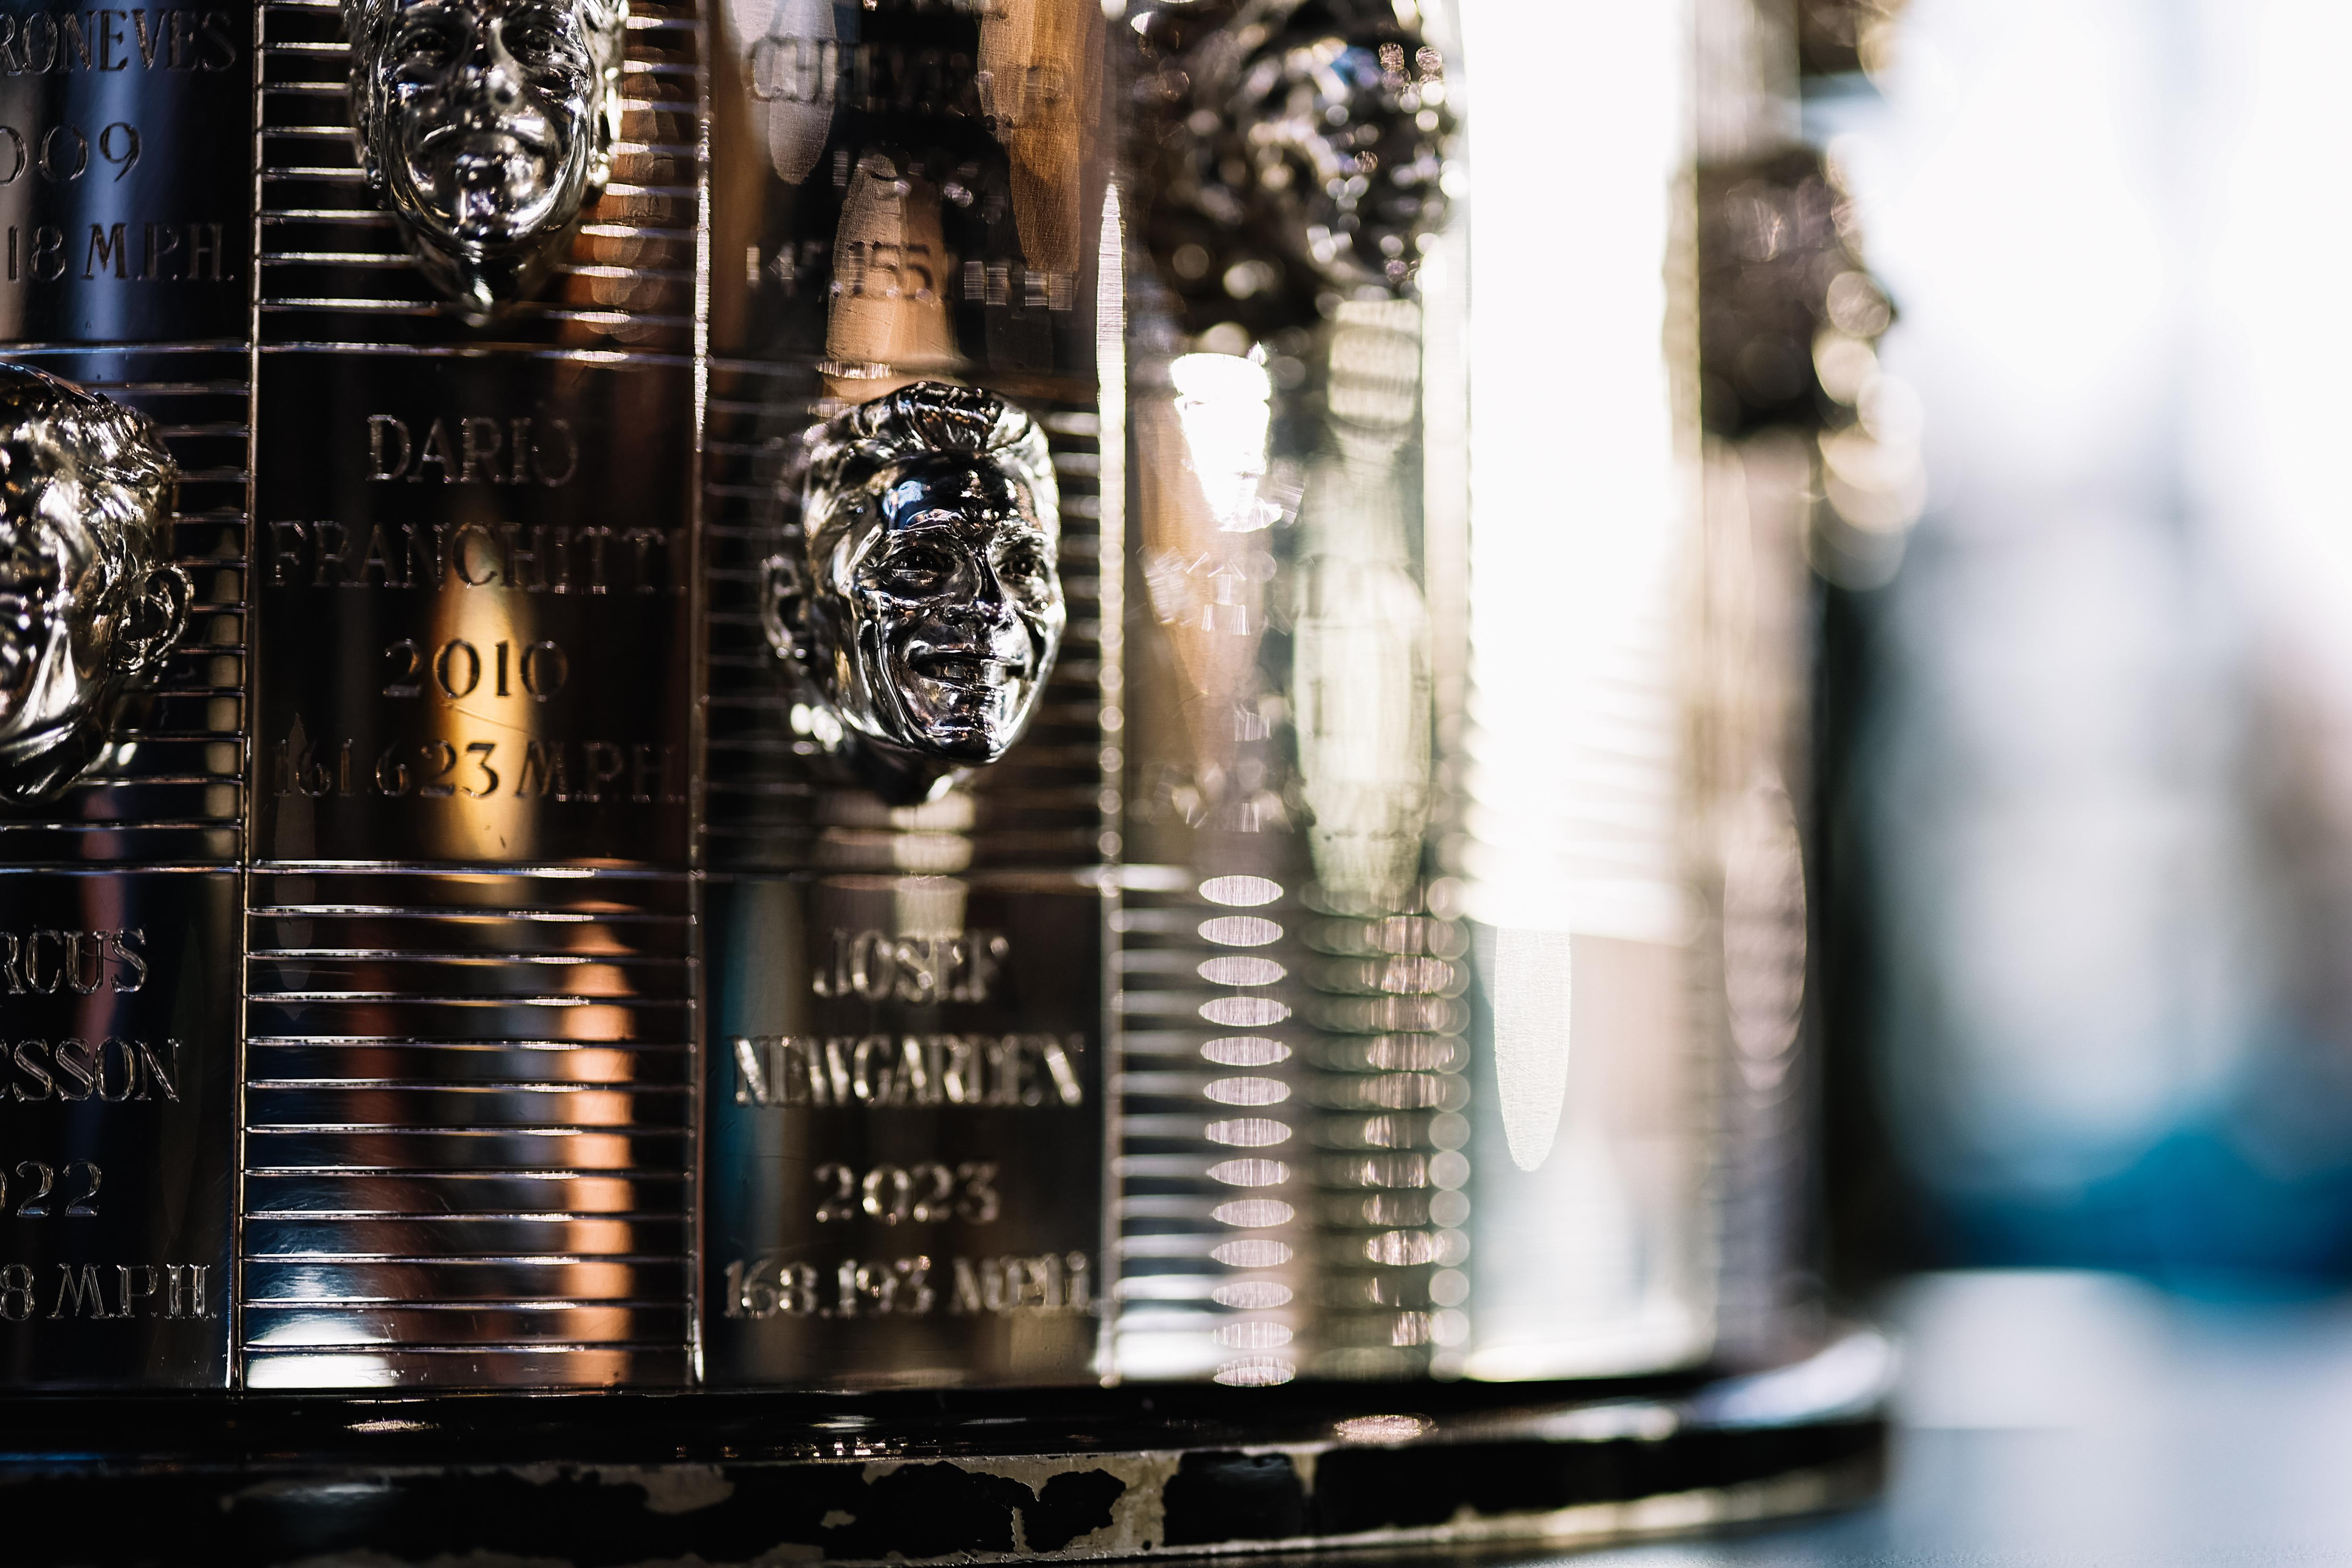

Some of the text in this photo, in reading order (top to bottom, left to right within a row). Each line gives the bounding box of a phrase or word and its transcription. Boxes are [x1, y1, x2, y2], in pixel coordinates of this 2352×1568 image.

[8, 222, 236, 283] 18 M.P.H.
[365, 414, 579, 488] DARIO
[268, 520, 689, 595] FRANCHITTI
[382, 638, 569, 703] 2010
[271, 738, 499, 799] 161.623
[0, 1160, 102, 1217] 22
[812, 1161, 1001, 1225] 2023
[0, 1263, 218, 1321] 8 M.P.H.
[721, 1253, 937, 1319] 168.193
